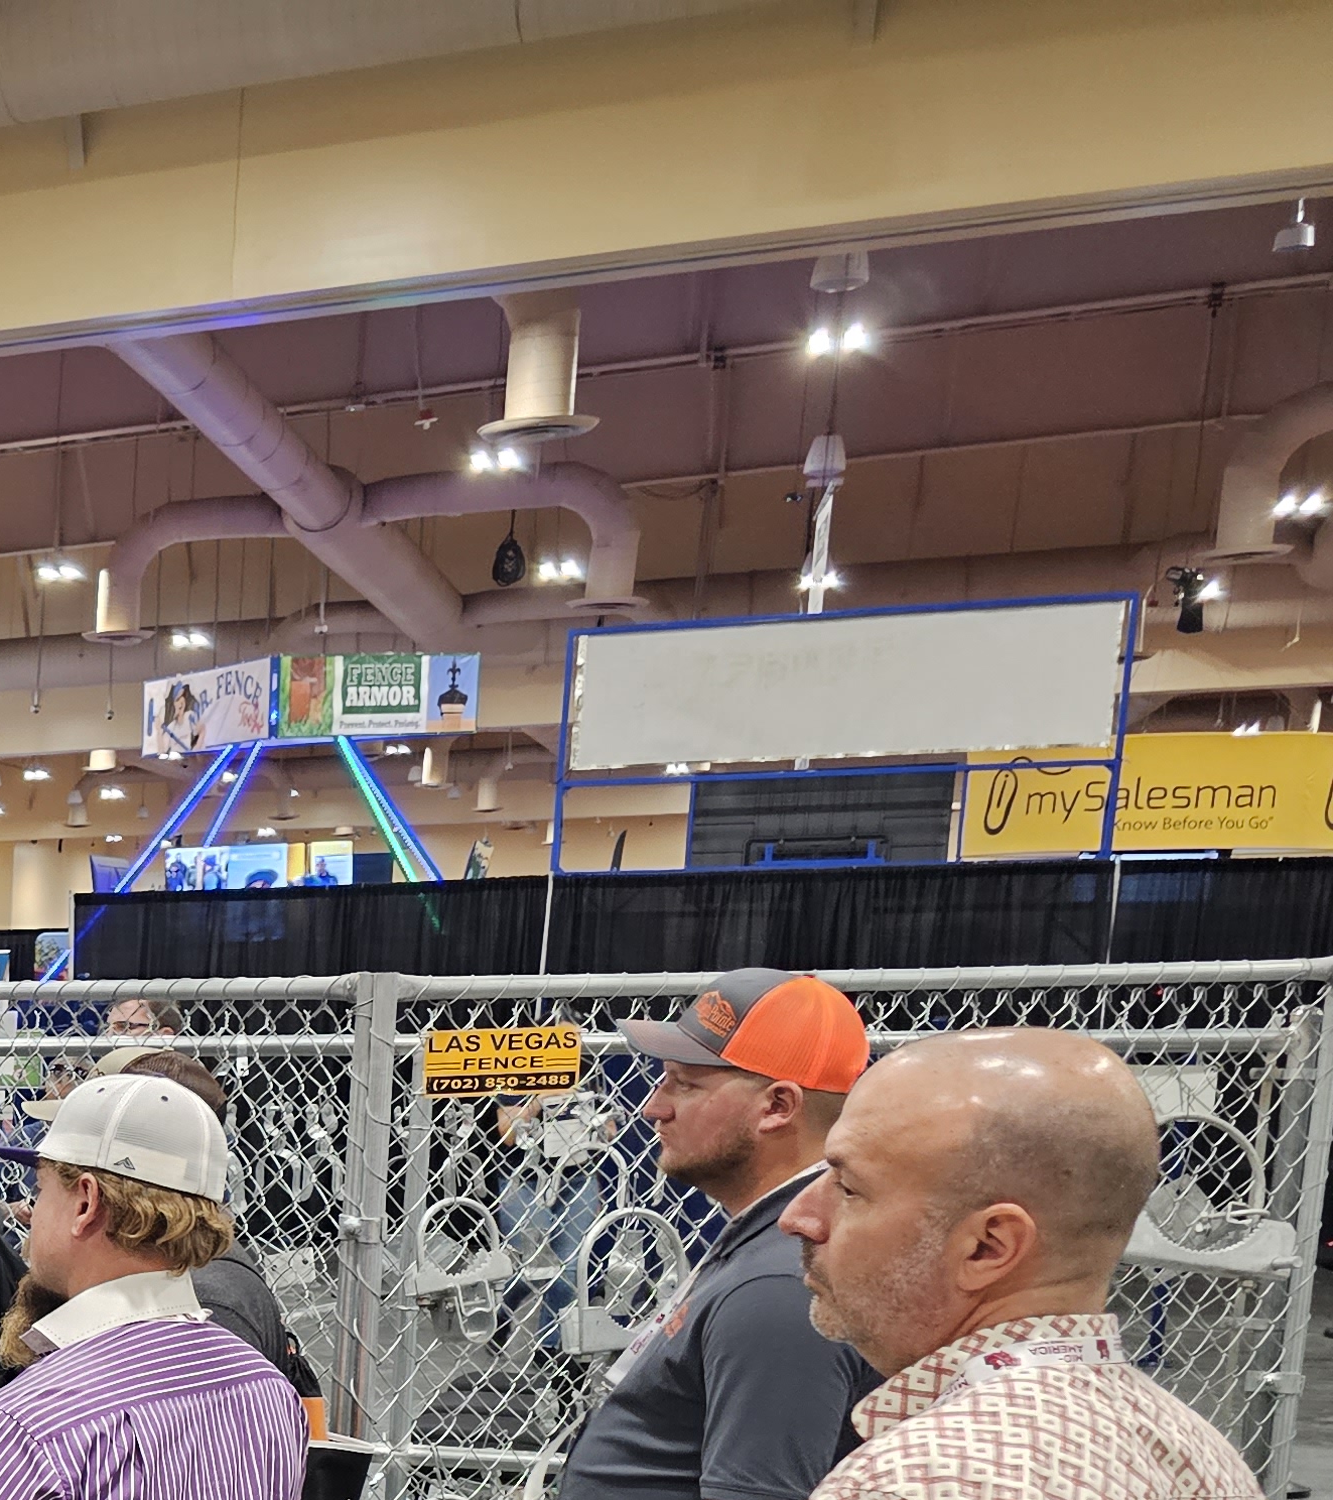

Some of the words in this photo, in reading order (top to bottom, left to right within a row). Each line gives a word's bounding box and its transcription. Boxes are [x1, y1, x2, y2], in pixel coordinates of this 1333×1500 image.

[346, 663, 415, 685] FENCE
[1025, 776, 1278, 824] mySalesman
[1162, 815, 1213, 830] Before
[1217, 816, 1245, 830] You
[428, 1034, 481, 1053] LAS
[490, 1031, 577, 1051] VEGAS
[463, 1056, 544, 1070] FENCE
[433, 1078, 479, 1092] (702)
[485, 1075, 570, 1088] 850-2488
